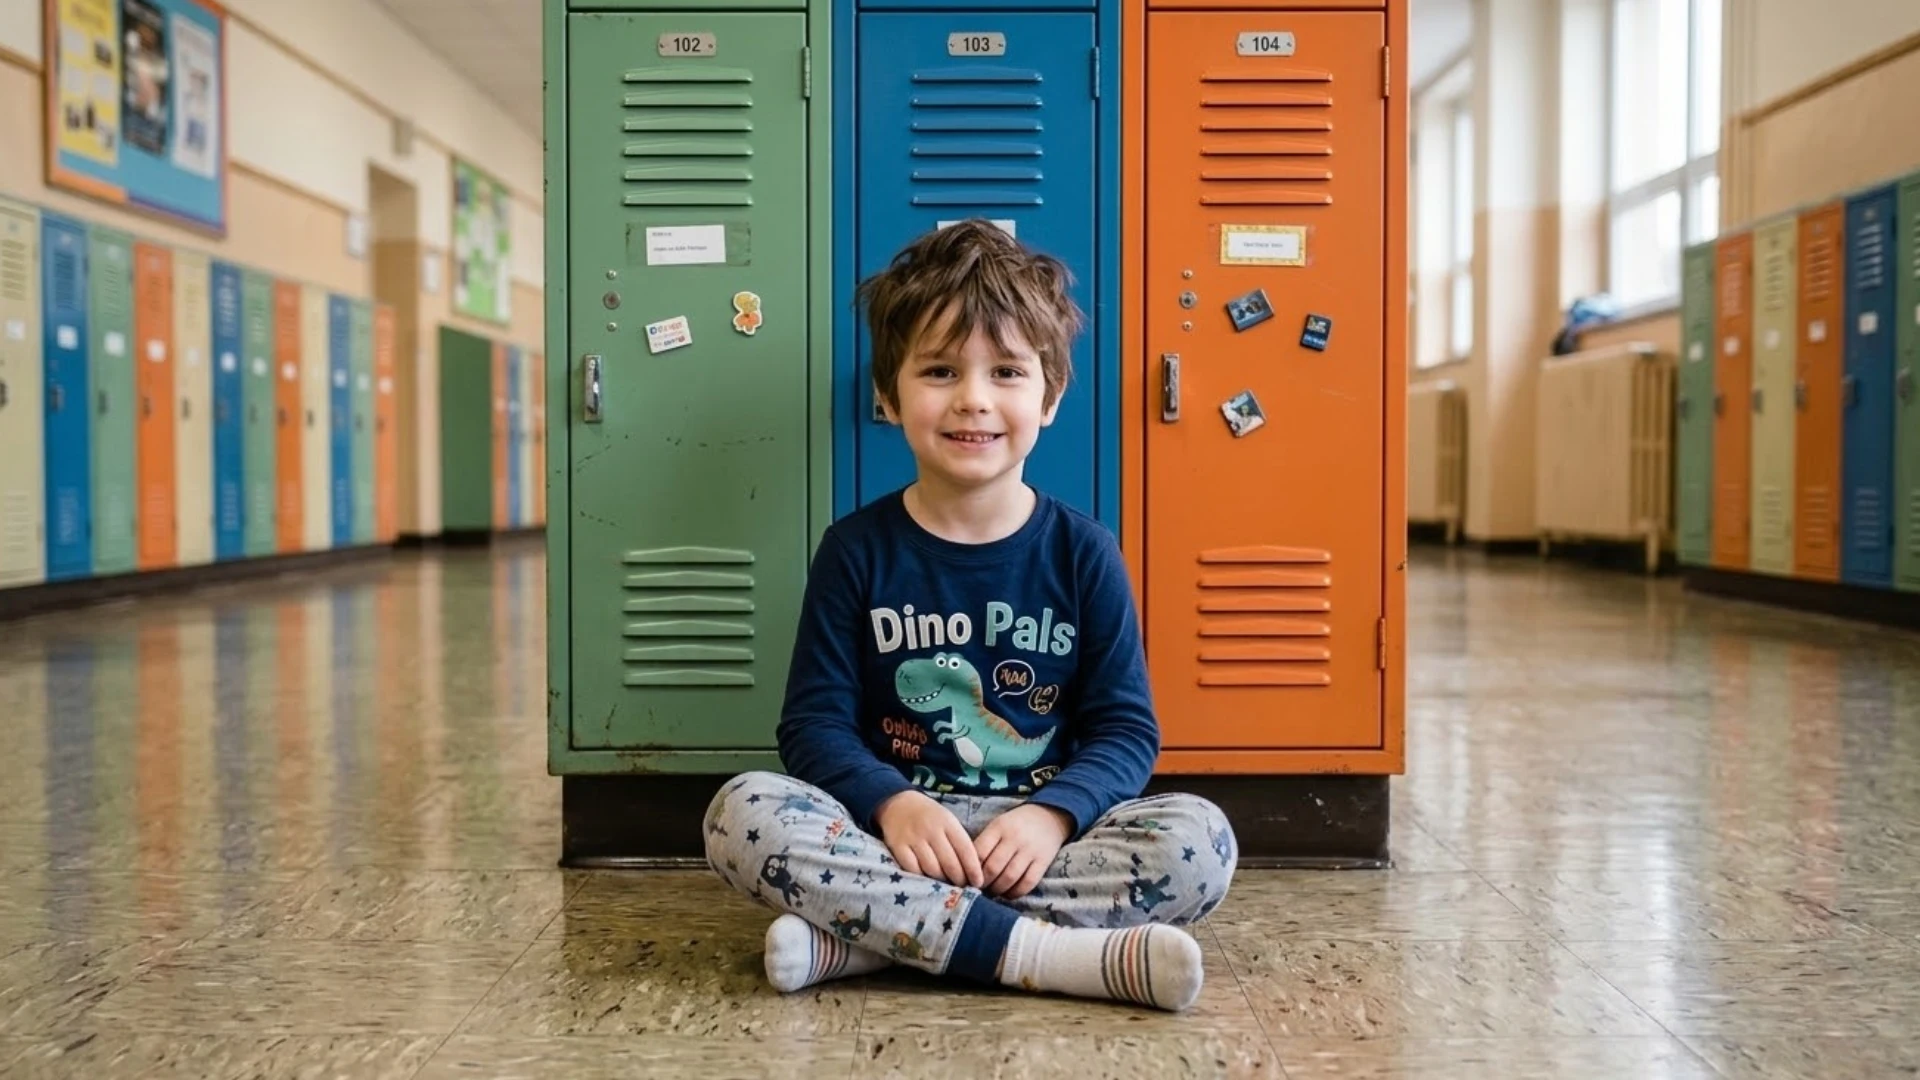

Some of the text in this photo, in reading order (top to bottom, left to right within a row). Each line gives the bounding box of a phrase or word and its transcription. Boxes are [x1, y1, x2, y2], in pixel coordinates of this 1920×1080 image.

[673, 37, 701, 53] 102
[962, 37, 990, 53] 103
[1252, 36, 1281, 52] 104
[869, 601, 1076, 656] Dino Pals
